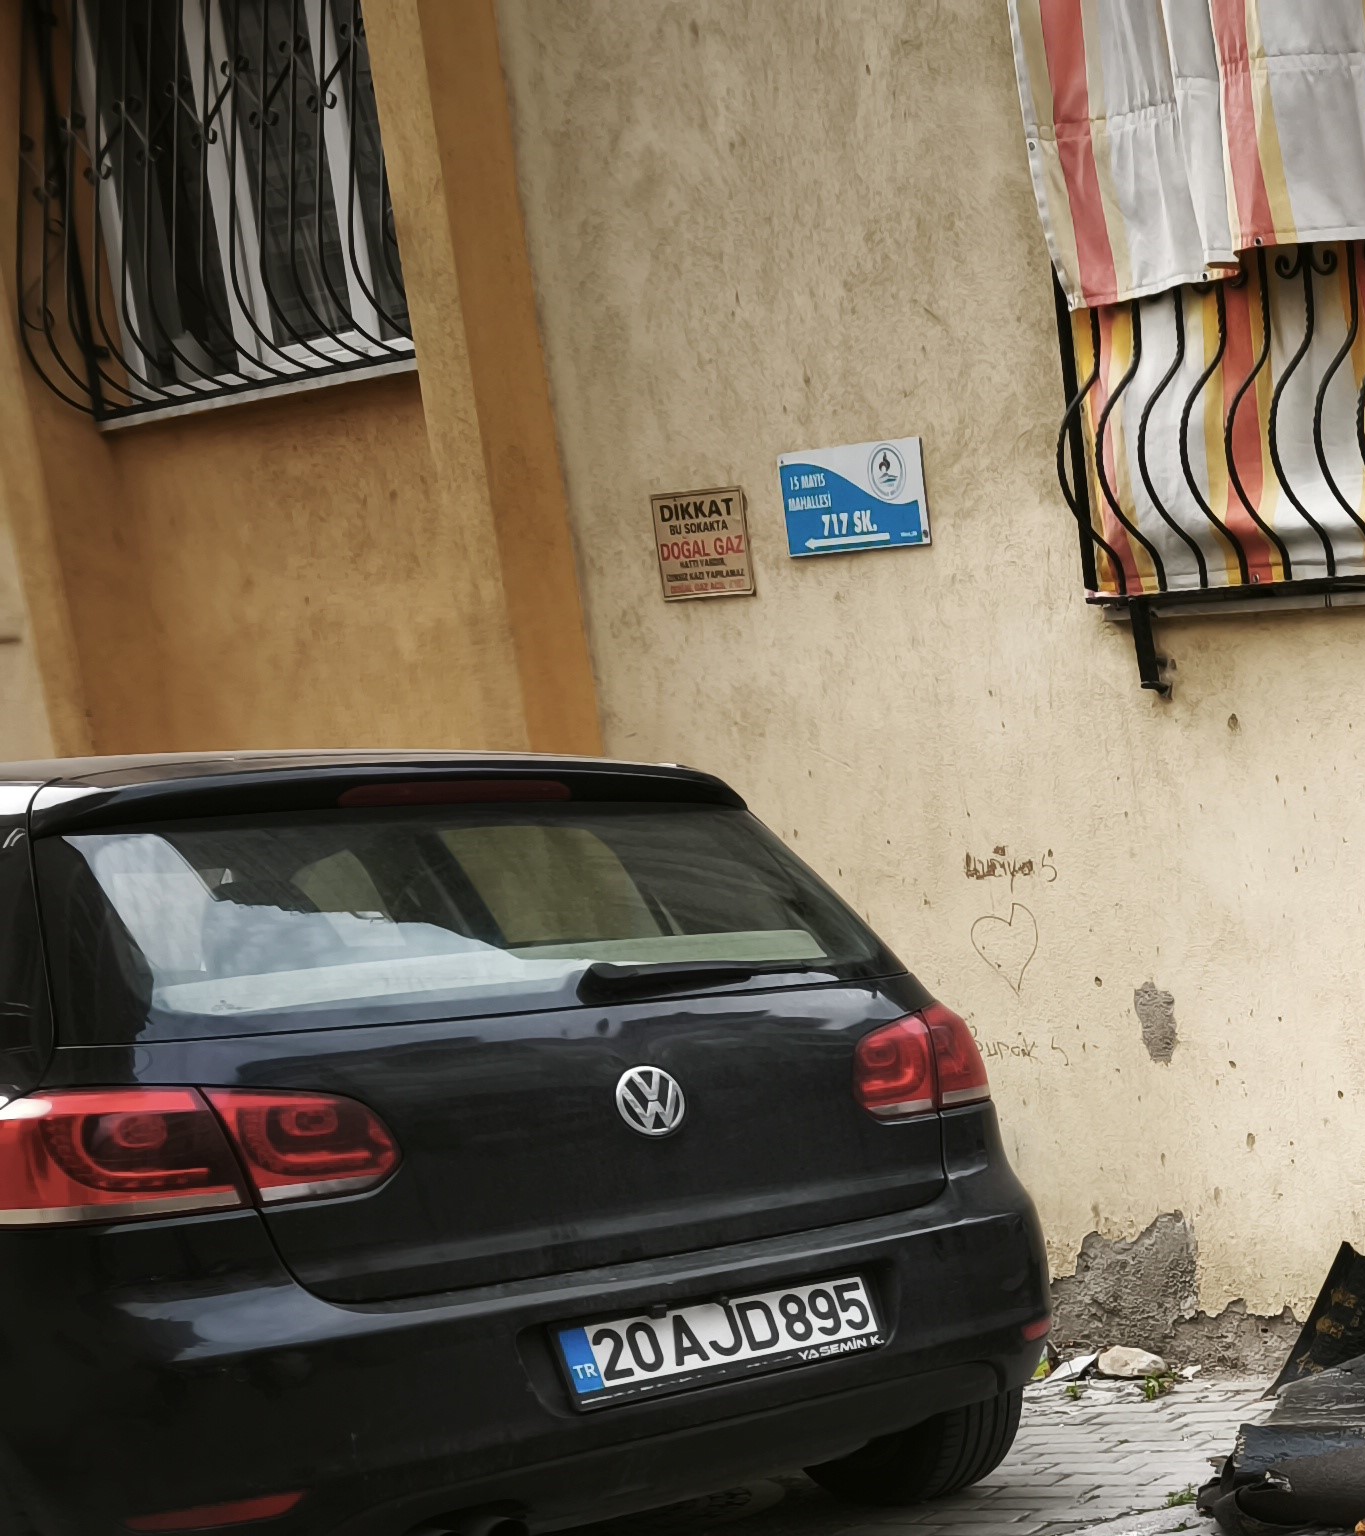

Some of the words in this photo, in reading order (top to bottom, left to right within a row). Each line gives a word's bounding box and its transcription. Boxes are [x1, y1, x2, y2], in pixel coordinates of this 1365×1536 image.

[790, 475, 799, 490] 15
[801, 473, 826, 489] MAYIS
[659, 497, 733, 522] DİKKAT
[788, 491, 831, 511] MAHALLESİ
[669, 523, 682, 535] BU
[684, 519, 728, 534] SOKAKTA
[821, 513, 848, 536] 717
[853, 510, 878, 533] SK.
[660, 536, 711, 561] DOĞAL
[713, 534, 745, 556] GAZ
[798, 1337, 867, 1362] YASEMİN
[869, 1334, 885, 1347] K.
[572, 1362, 598, 1380] TR
